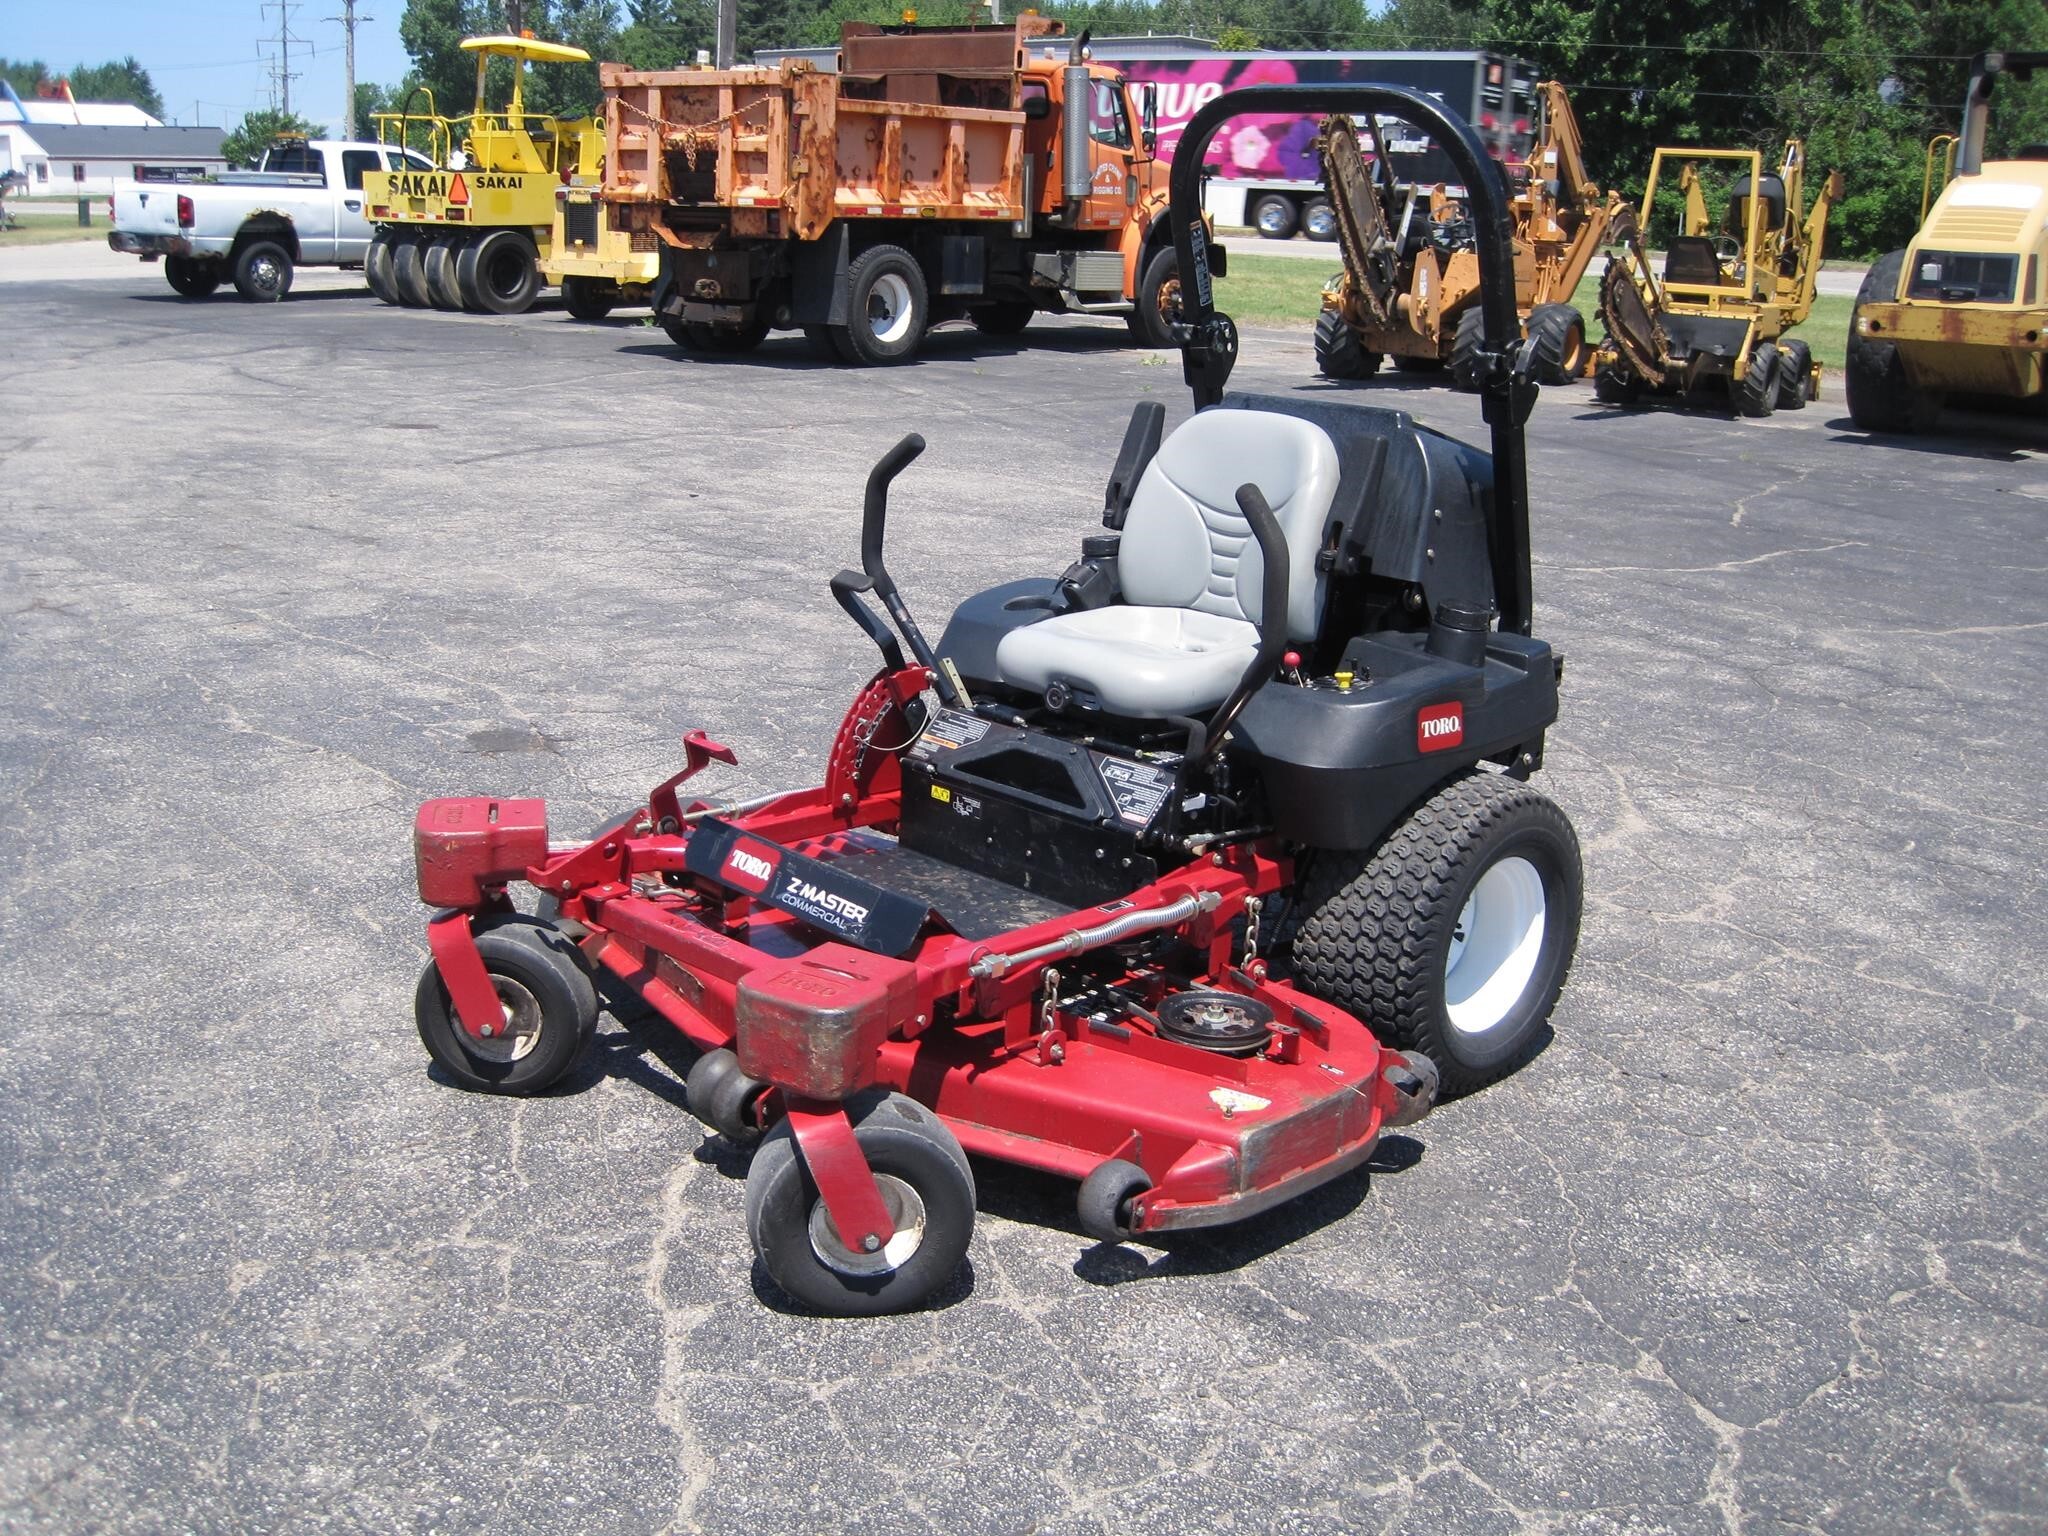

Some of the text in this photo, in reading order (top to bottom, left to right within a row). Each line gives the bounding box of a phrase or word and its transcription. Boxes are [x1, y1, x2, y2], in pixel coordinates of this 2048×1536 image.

[388, 175, 446, 197] SAKAI
[476, 176, 522, 189] SAKAI
[1421, 715, 1460, 738] TORO
[730, 849, 772, 881] TORO
[781, 893, 847, 930] COMMERCIAL
